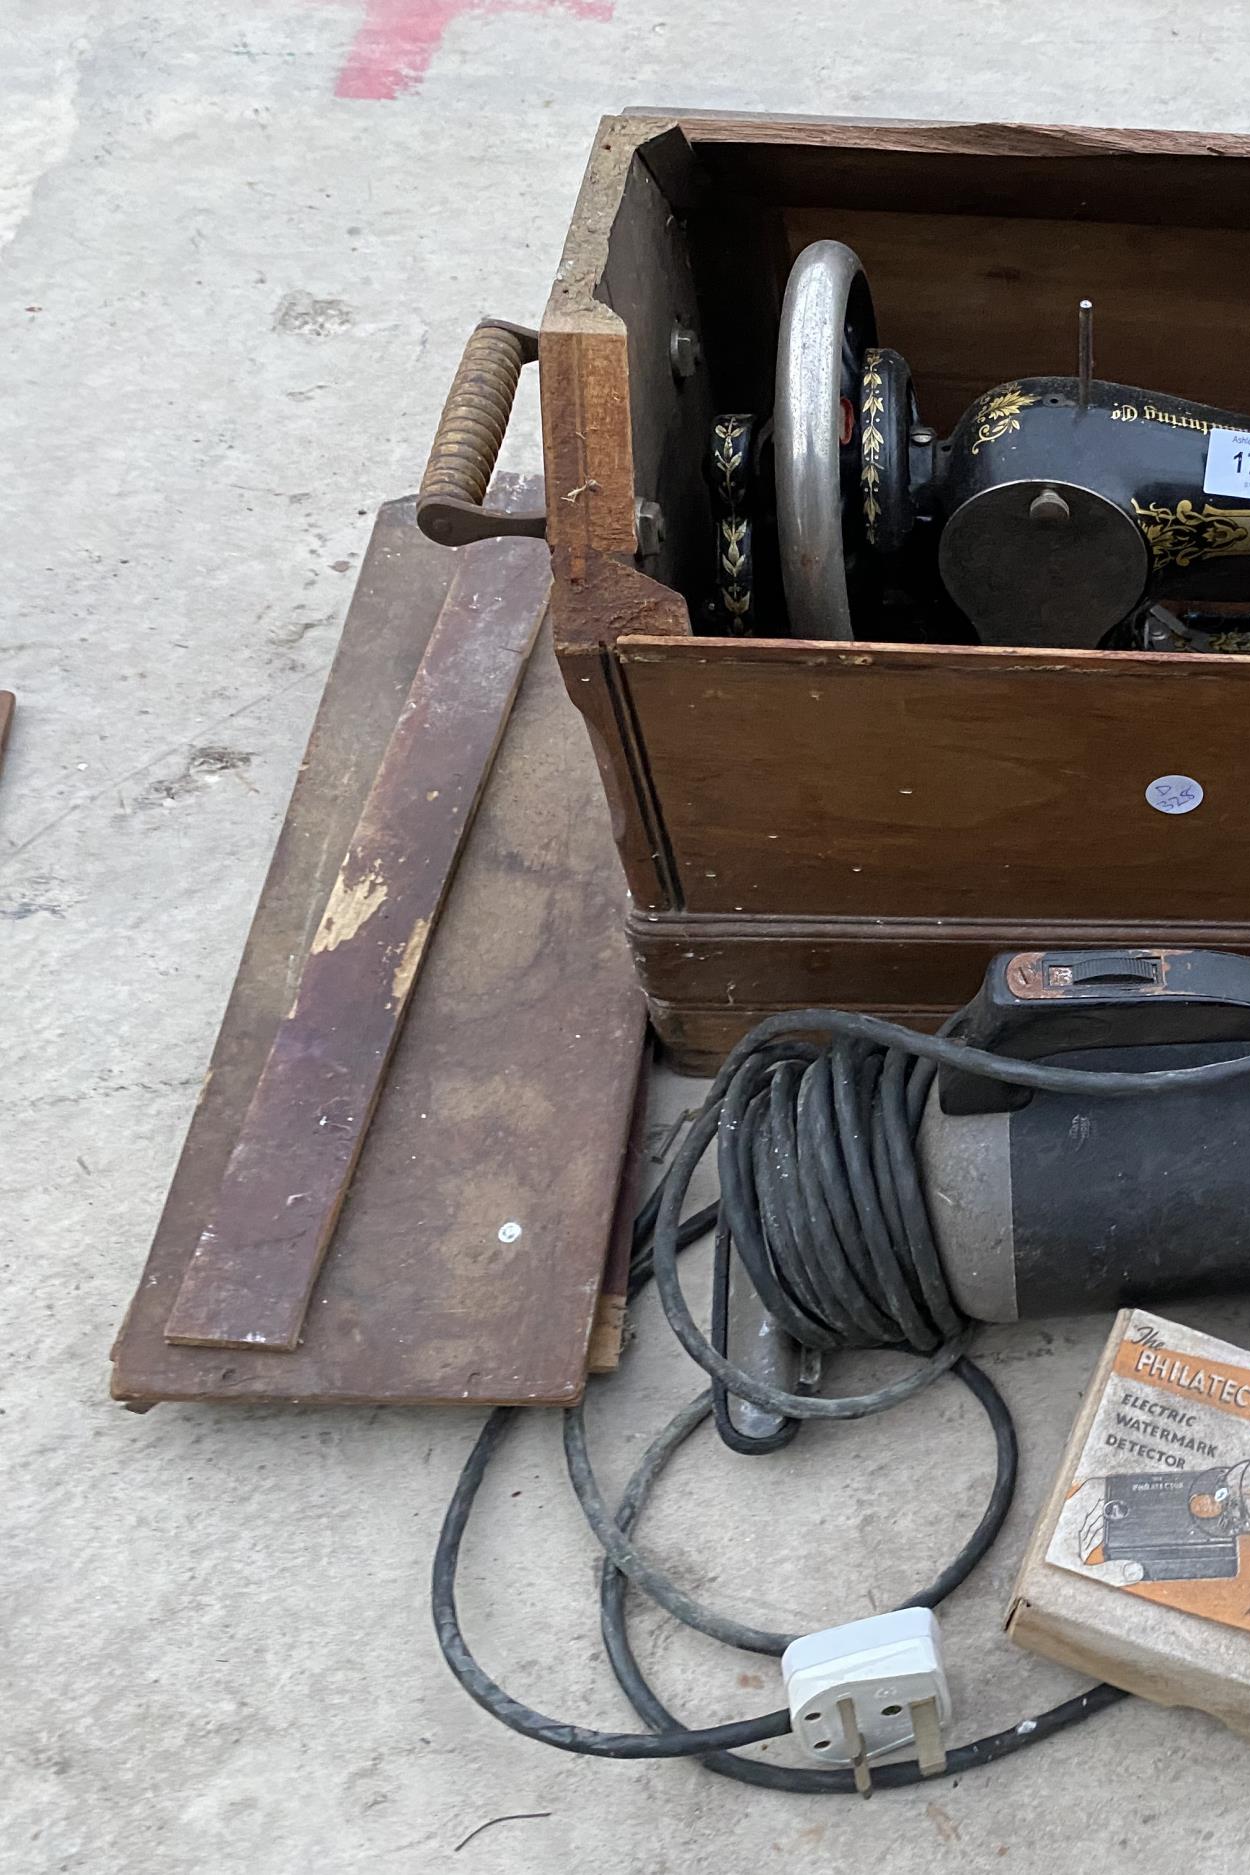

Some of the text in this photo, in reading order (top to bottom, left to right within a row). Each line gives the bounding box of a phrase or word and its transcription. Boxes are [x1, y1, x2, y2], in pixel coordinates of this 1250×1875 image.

[1130, 1326, 1166, 1350] The
[1121, 1393, 1198, 1427] ELECTRIC
[1105, 1433, 1187, 1471] DETECTOR
[1116, 1412, 1220, 1458] WATERMARK
